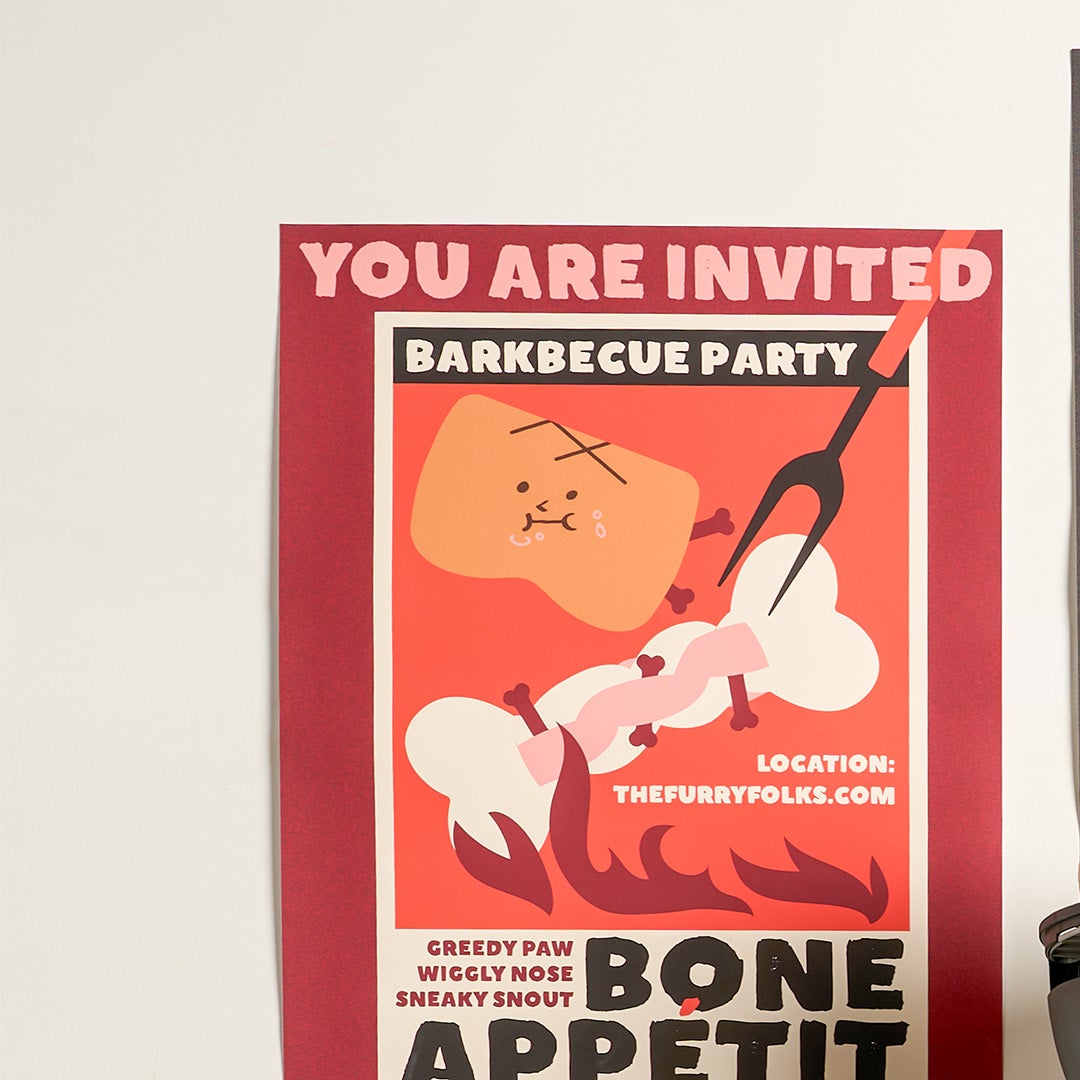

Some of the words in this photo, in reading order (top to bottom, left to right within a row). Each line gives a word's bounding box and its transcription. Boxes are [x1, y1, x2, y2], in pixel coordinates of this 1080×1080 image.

[299, 241, 470, 299] YOU
[488, 244, 645, 300] ARE
[665, 245, 993, 302] INVITED
[404, 338, 690, 375] BARKBECUE
[702, 341, 858, 377] PARTY
[756, 754, 896, 774] LOCATION:
[612, 784, 896, 806] THEFURRYFOLKS.COM
[427, 940, 517, 957] GREEDY
[522, 940, 574, 957] PAW
[417, 965, 506, 982] WIGGLY
[511, 965, 574, 982] NOSE
[585, 936, 904, 1012] BONE
[395, 991, 489, 1008] SNEAKY
[492, 991, 574, 1008] SNOUT
